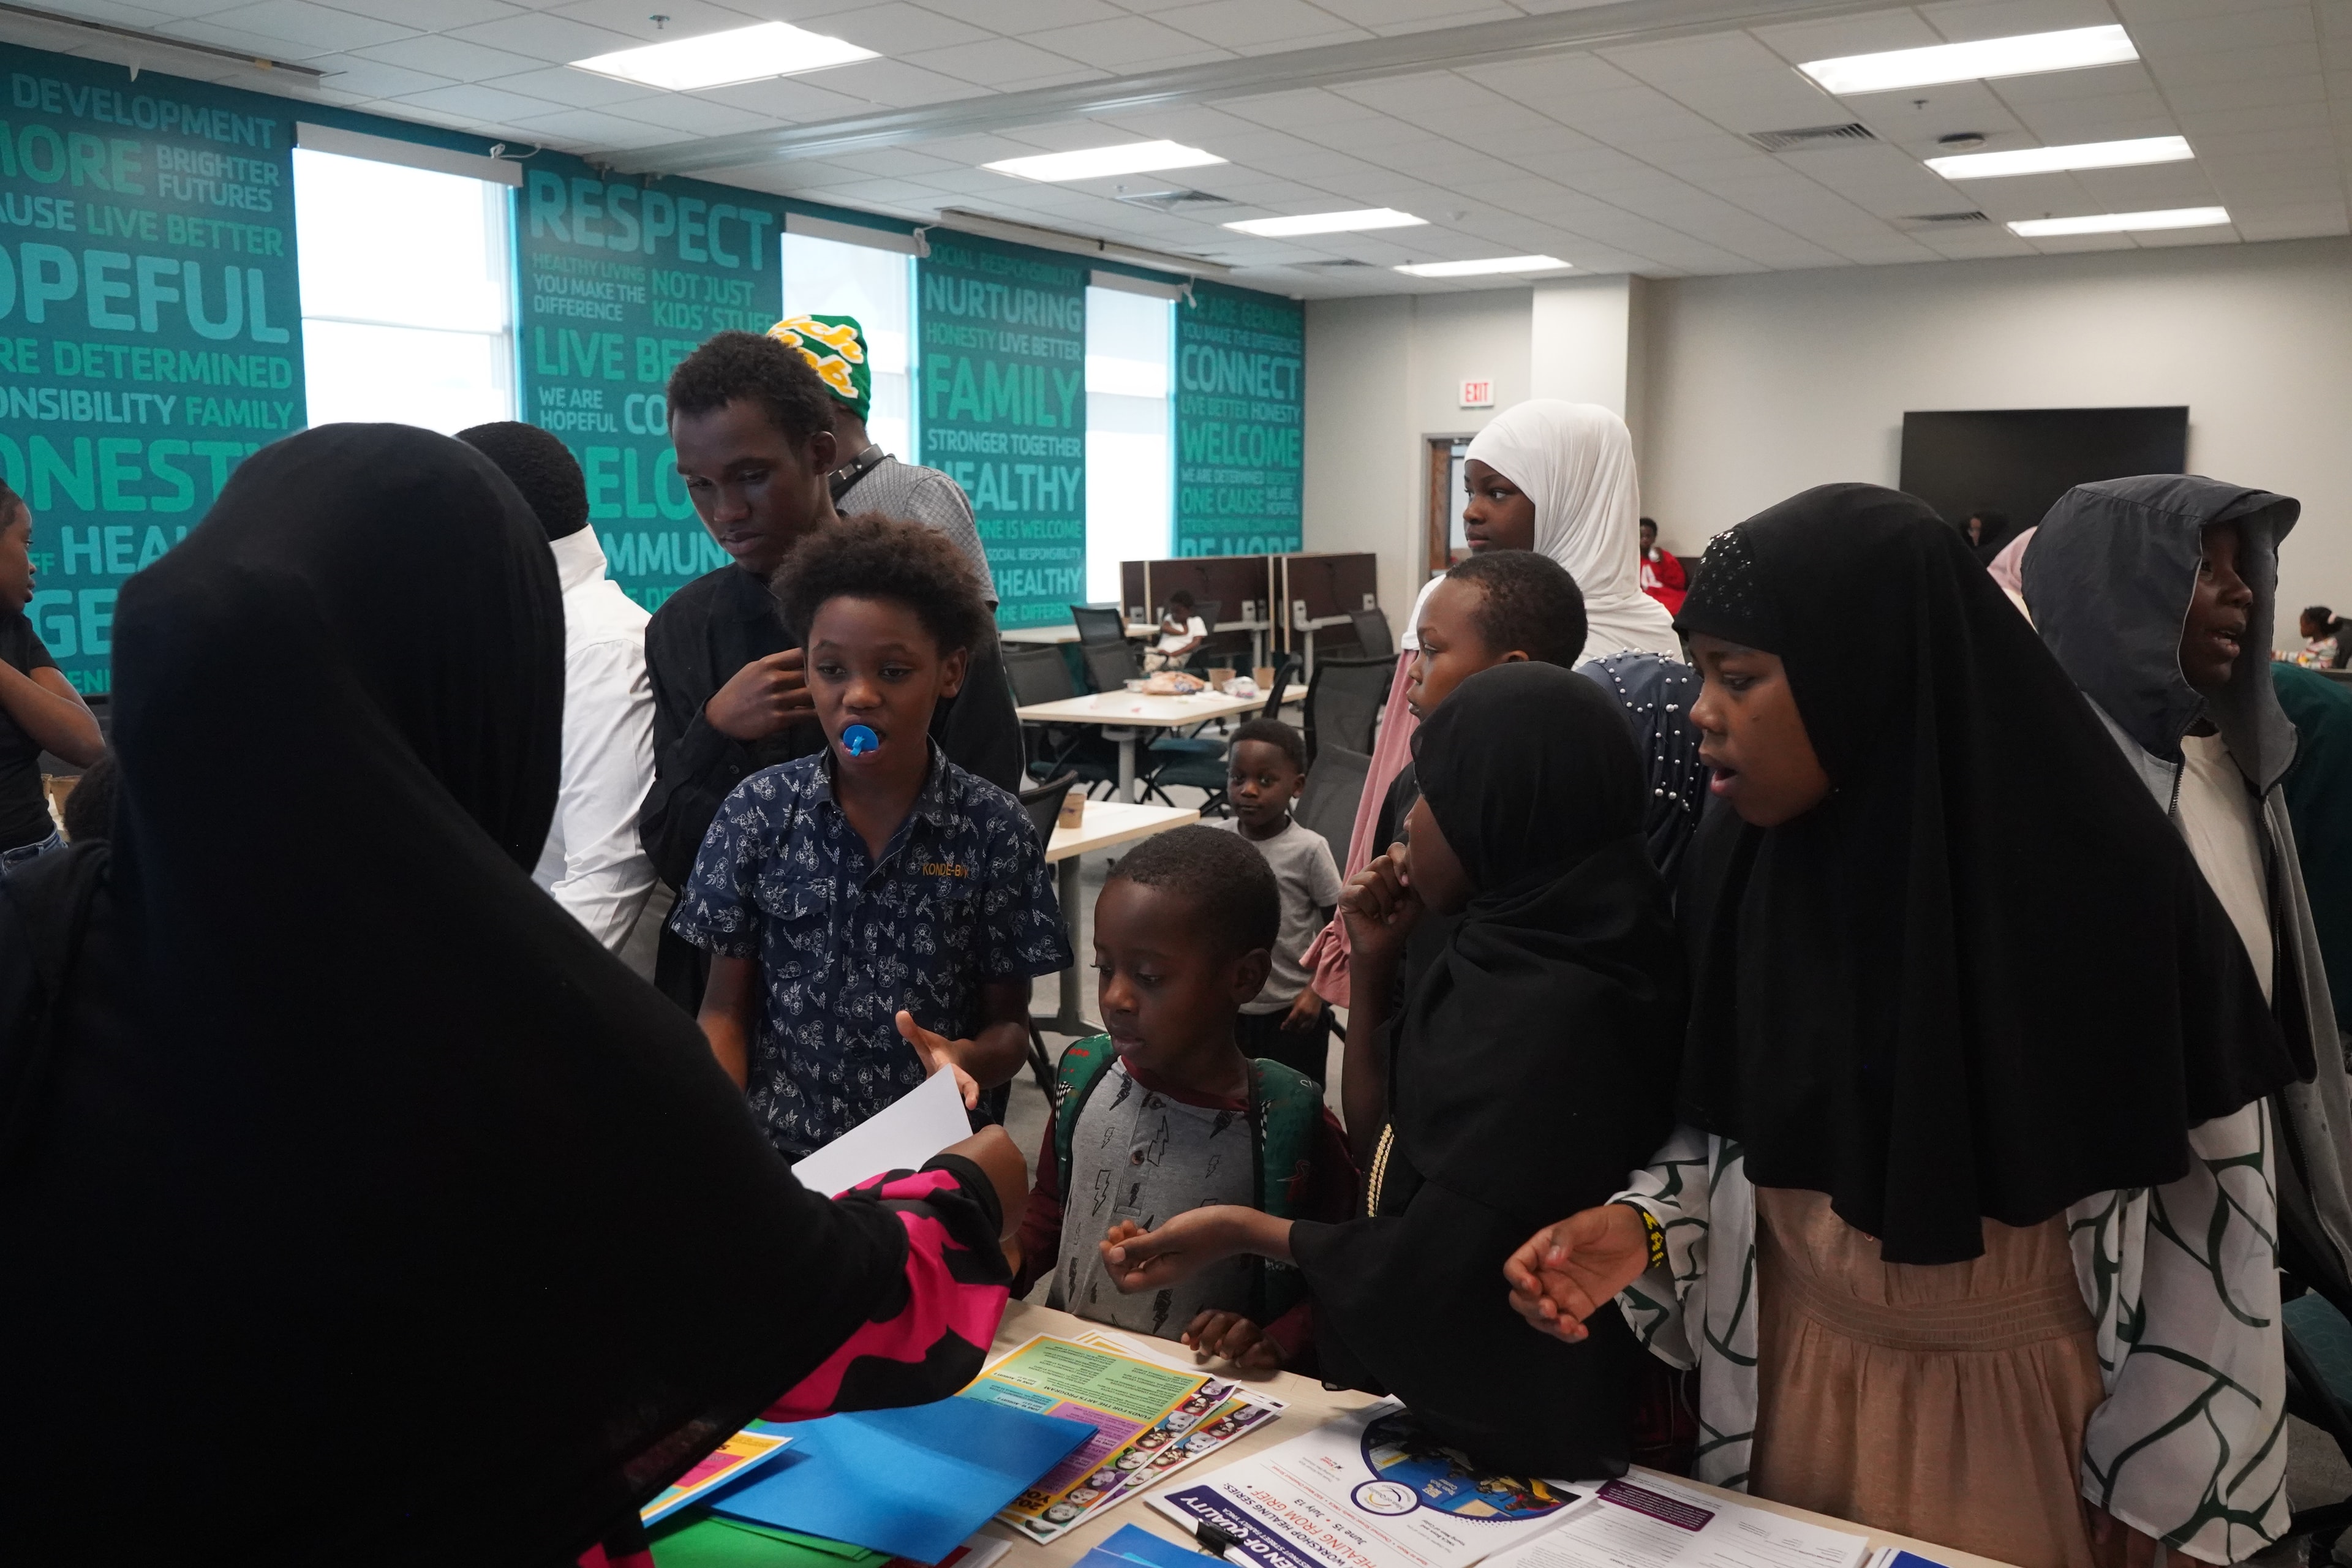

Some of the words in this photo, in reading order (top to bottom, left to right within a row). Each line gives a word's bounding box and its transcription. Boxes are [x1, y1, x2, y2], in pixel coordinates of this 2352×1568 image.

[12, 72, 277, 150] DEVELOPMENT
[156, 144, 280, 187] BRIGHTER
[157, 175, 274, 213] FUTURES
[86, 203, 160, 243] LIVE
[167, 214, 284, 258] BETTER
[529, 168, 774, 271] RESPECT
[532, 252, 599, 279] HEALTHY
[600, 260, 646, 284] LIVING
[0, 241, 290, 344] PEFUL
[533, 273, 568, 295] YOU
[571, 277, 615, 301] MAKE
[616, 284, 646, 305] THE
[652, 268, 699, 300] NOT
[704, 276, 756, 307] JUST
[925, 272, 1082, 333] NURTURING
[533, 294, 624, 323] DIFFERENCE
[652, 300, 709, 331] KIDS'
[535, 325, 626, 381] LIVE
[926, 321, 997, 351] HONESTY
[998, 331, 1030, 355] LIVE
[1030, 336, 1082, 361] BETTER
[53, 340, 293, 390] DETERMINED
[1181, 344, 1302, 401] CONNECT
[538, 385, 567, 407] WE
[569, 388, 603, 410] ARE
[927, 352, 1083, 429] FAMILY
[1466, 382, 1489, 402] EXIT
[186, 396, 295, 430] FAMILY
[540, 409, 619, 434] HOPEFUL
[927, 428, 1009, 454] STRONGER
[1011, 434, 1082, 459] TOGETHER
[1181, 419, 1301, 469] WELCOME
[1181, 486, 1214, 514] ONE
[1217, 488, 1265, 514] CAUSE
[1005, 519, 1019, 539] IS
[1020, 519, 1082, 539] WELCOME
[61, 526, 187, 575] HEA
[998, 567, 1083, 597] HEALTHY
[1042, 1385, 1079, 1398] PROGRAM
[1126, 1410, 1152, 1419] FUNDS
[1270, 1466, 1286, 1475] Street
[1283, 1474, 1305, 1487] Chestnut
[1219, 1482, 1257, 1505] SERIES:
[1249, 1489, 1289, 1511] GRIEF
[1302, 1485, 1316, 1494] West
[1178, 1494, 1251, 1539] QUALITY
[1219, 1507, 1243, 1521] YMCA
[1251, 1504, 1294, 1530] HEALING
[1282, 1510, 1325, 1535] FROM
[1303, 1504, 1327, 1517] July
[1354, 1519, 1371, 1529] Street
[1237, 1519, 1264, 1535] FAMILY
[1259, 1534, 1286, 1550] STREET
[1341, 1529, 1368, 1544] June
[1369, 1528, 1393, 1542] Chestnut
[1240, 1536, 1272, 1553] OF
[1289, 1529, 1347, 1566] WORKSHOP
[1316, 1533, 1378, 1568] HEALING
